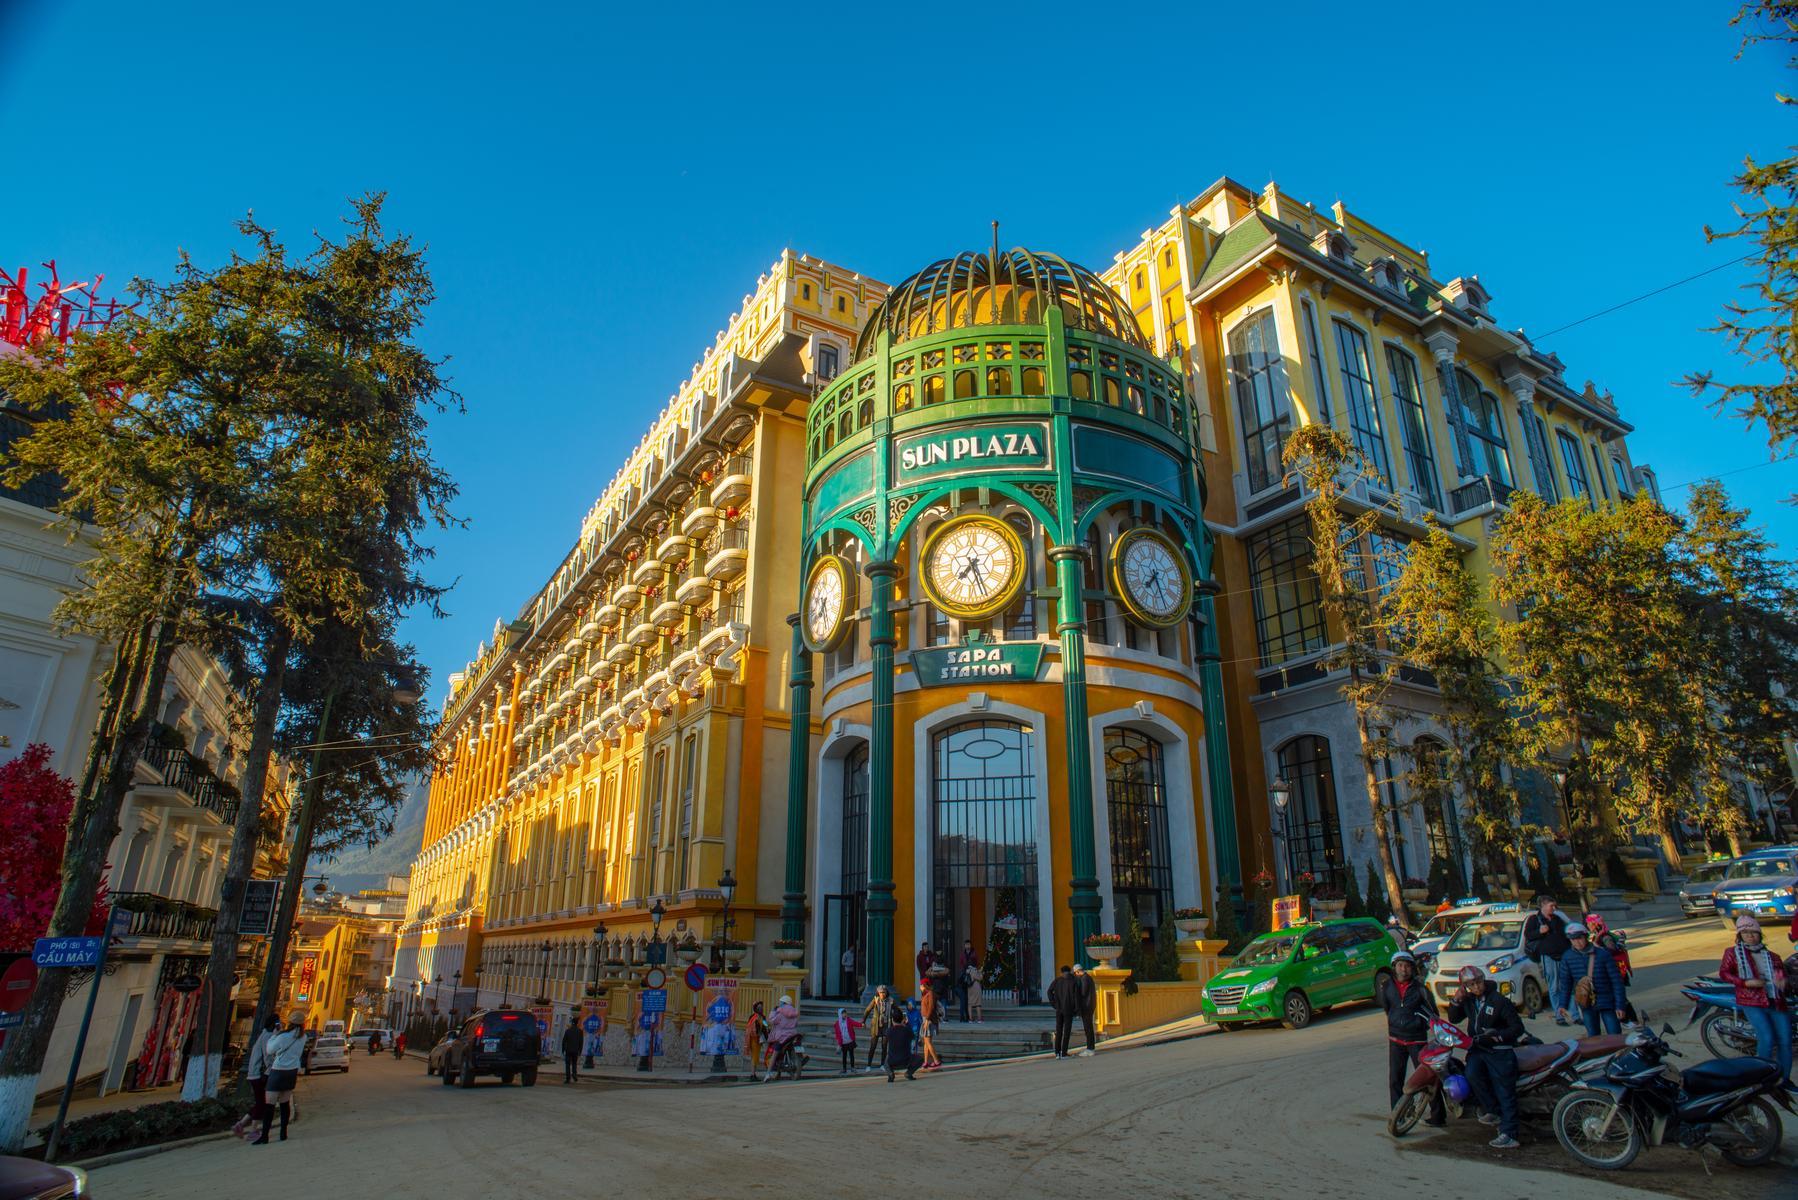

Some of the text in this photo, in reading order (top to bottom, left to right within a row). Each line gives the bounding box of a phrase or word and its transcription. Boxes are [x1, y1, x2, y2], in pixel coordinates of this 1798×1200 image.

[902, 433, 1037, 470] SUN PLAZA
[947, 648, 1001, 664] SAPA
[941, 662, 1012, 679] STATION
[65, 951, 94, 963] MÂY
